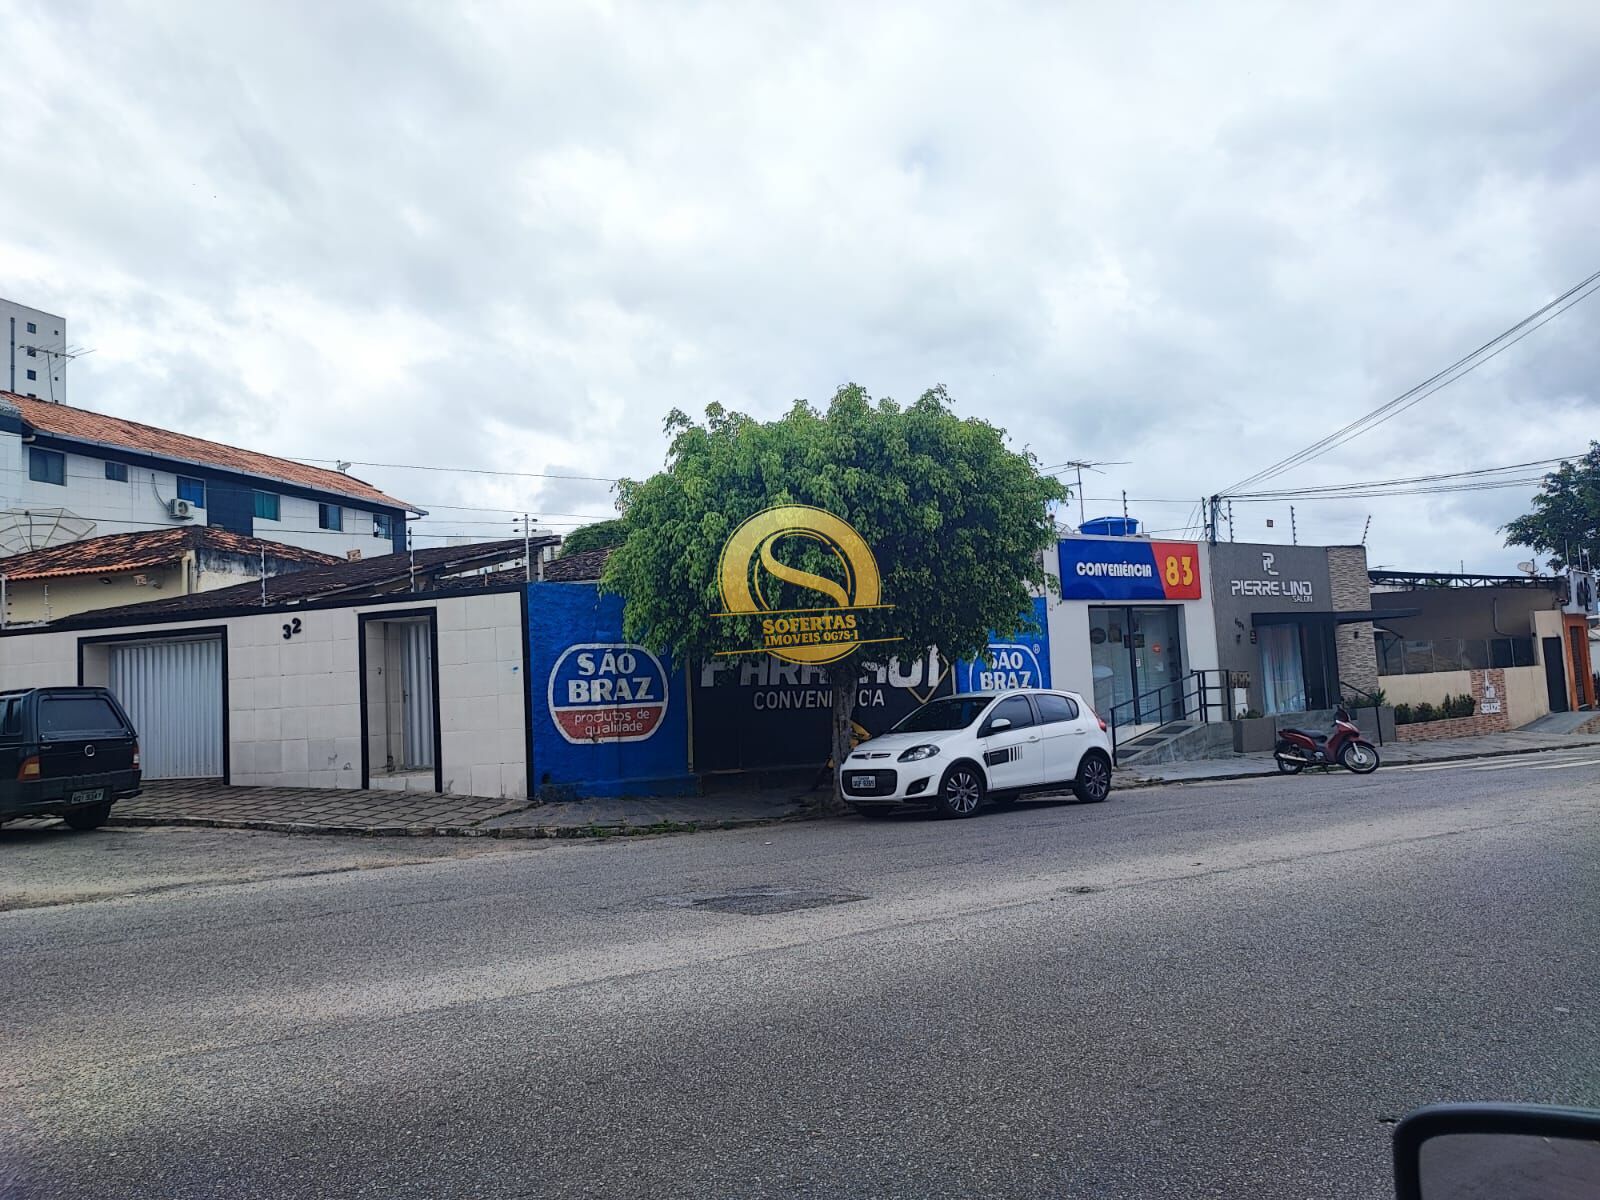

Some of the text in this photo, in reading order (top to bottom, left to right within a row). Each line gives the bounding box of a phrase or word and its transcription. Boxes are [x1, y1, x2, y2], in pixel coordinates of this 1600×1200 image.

[1165, 555, 1193, 586] 83
[1231, 580, 1313, 596] PIERRE LINO
[282, 617, 302, 640] 32
[568, 677, 654, 703] BRAZ
[980, 671, 1032, 690] BRAZ
[753, 689, 885, 710] CONVENICIA
[575, 708, 650, 725] produtos de
[585, 721, 643, 736] qualidade
